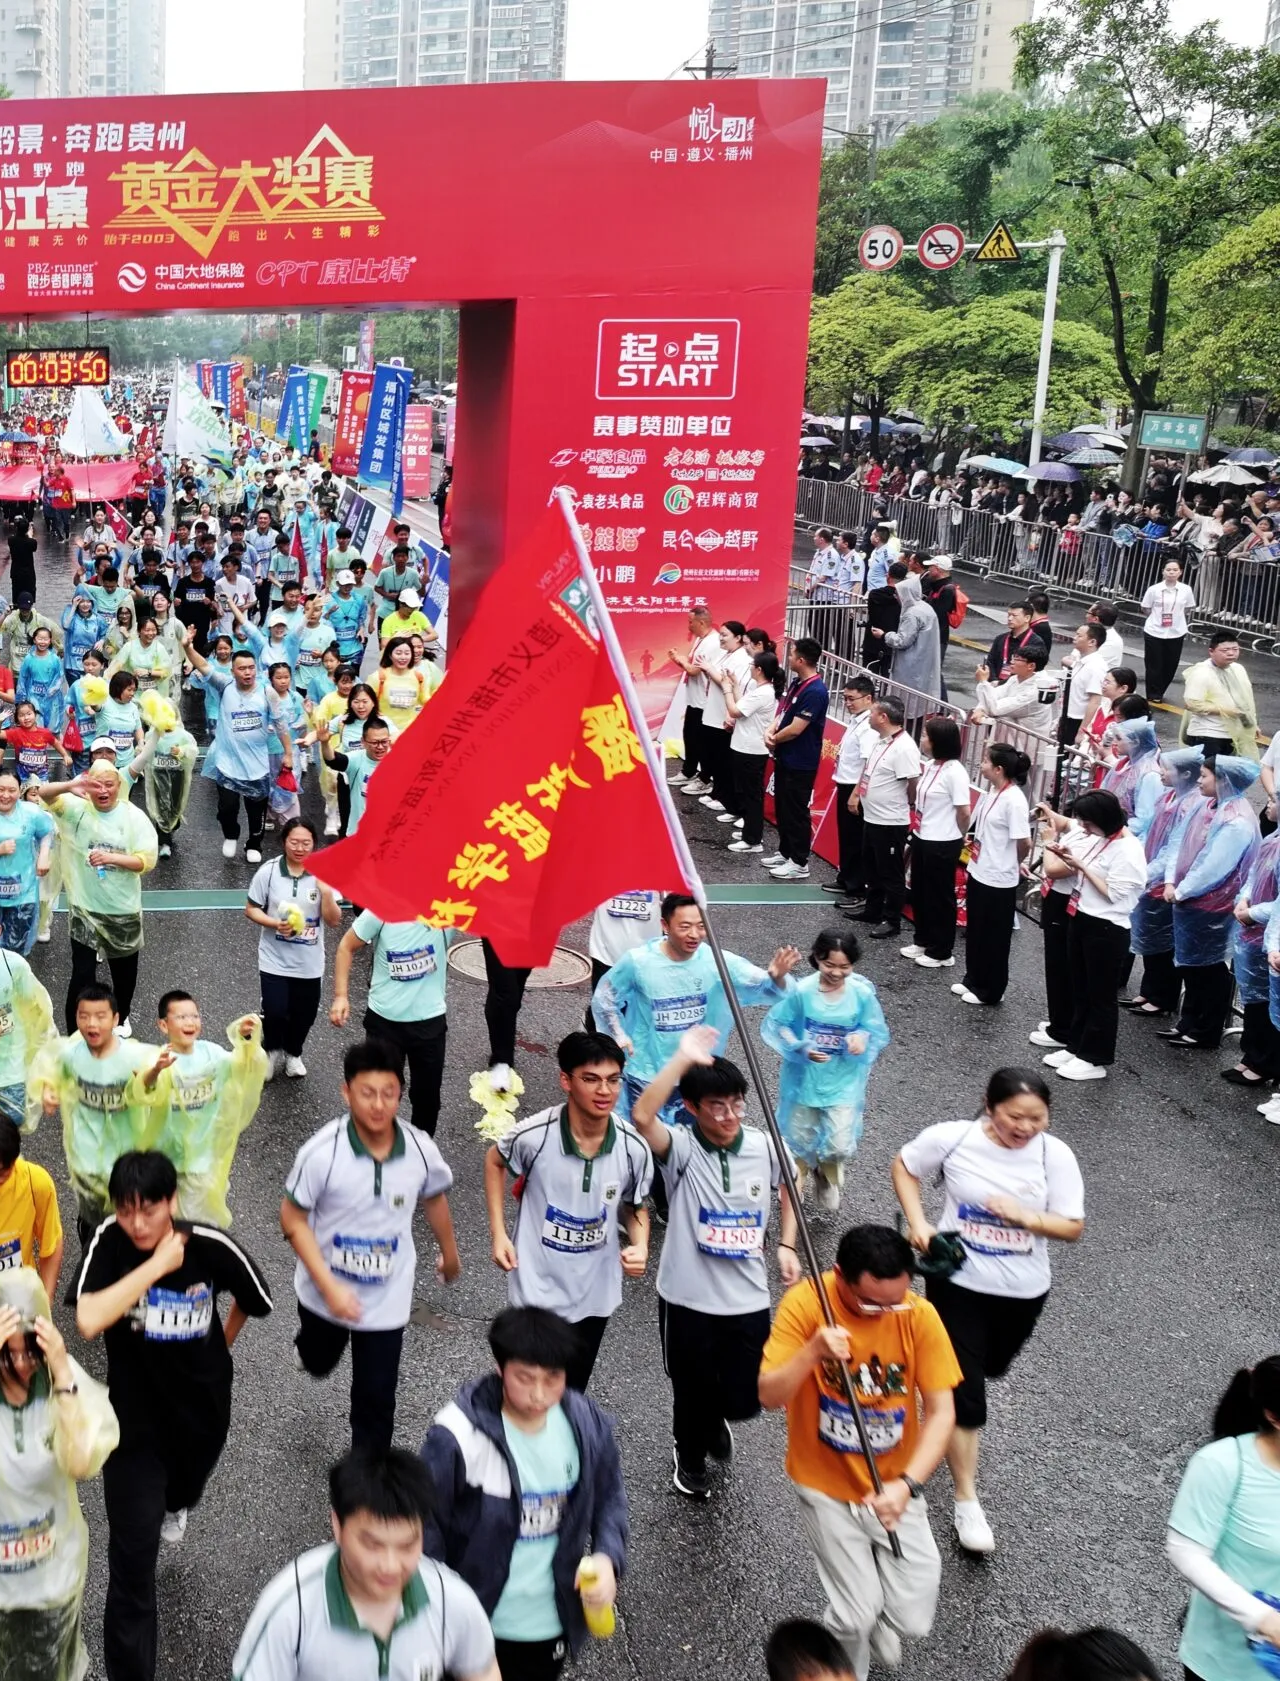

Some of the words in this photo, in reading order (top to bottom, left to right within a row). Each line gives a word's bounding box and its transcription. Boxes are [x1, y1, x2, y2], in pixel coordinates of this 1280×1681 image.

[106, 124, 381, 230] 黄金大奖赛
[4, 234, 90, 248] 健康无价
[228, 225, 381, 242] 跑出人生精彩
[868, 238, 893, 260] 50
[155, 263, 245, 279] 中国大地保险
[155, 282, 176, 291] China
[177, 282, 209, 291] Continent
[211, 282, 245, 290] Insurance
[620, 332, 720, 362] 起点
[11, 359, 106, 384] 00:03:50
[617, 364, 719, 387] START
[593, 415, 732, 437] 赛事赞助单位
[582, 493, 644, 510] 袁老头食品
[696, 491, 759, 509] 程辉商贸
[576, 523, 641, 552] 果熊猫
[611, 899, 647, 913] 11228
[391, 963, 404, 973] JH
[655, 1012, 670, 1022] JH
[673, 1007, 706, 1020] 20289
[551, 1224, 605, 1244] 11385
[706, 1227, 757, 1245] 21503
